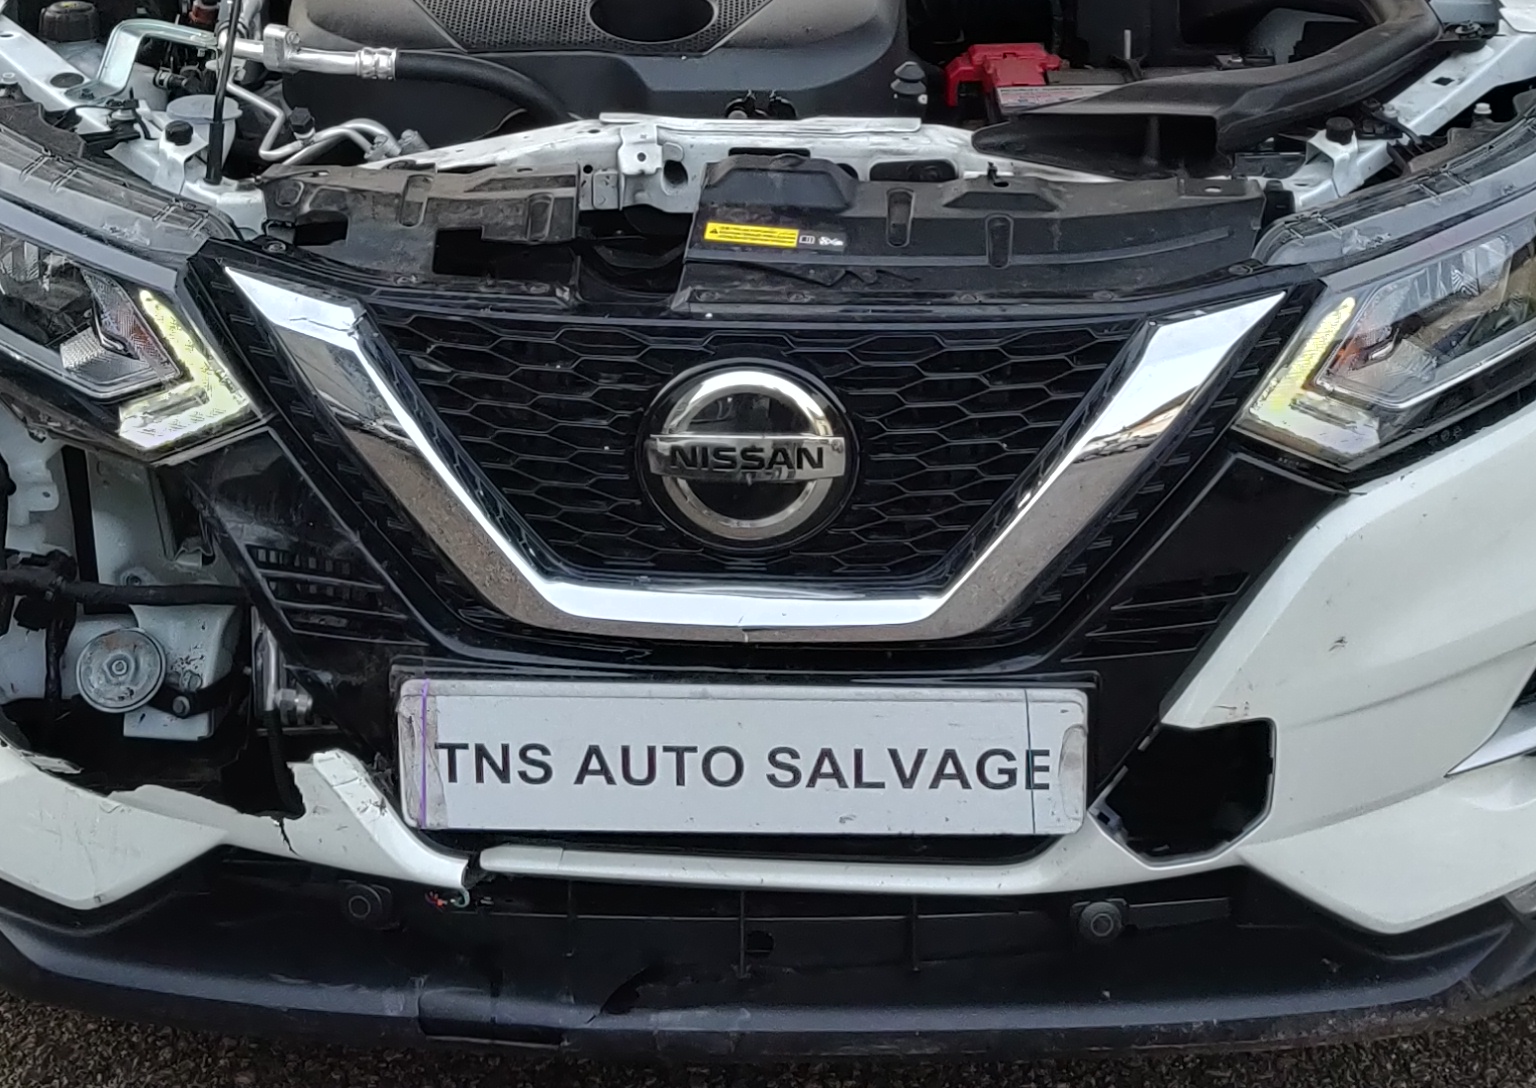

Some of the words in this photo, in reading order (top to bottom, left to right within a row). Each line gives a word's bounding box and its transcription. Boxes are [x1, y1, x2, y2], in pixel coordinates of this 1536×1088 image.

[669, 445, 824, 471] NISSAN
[433, 742, 554, 786] TNS
[573, 744, 746, 788] AUTO
[765, 745, 1051, 791] SALVAGE
